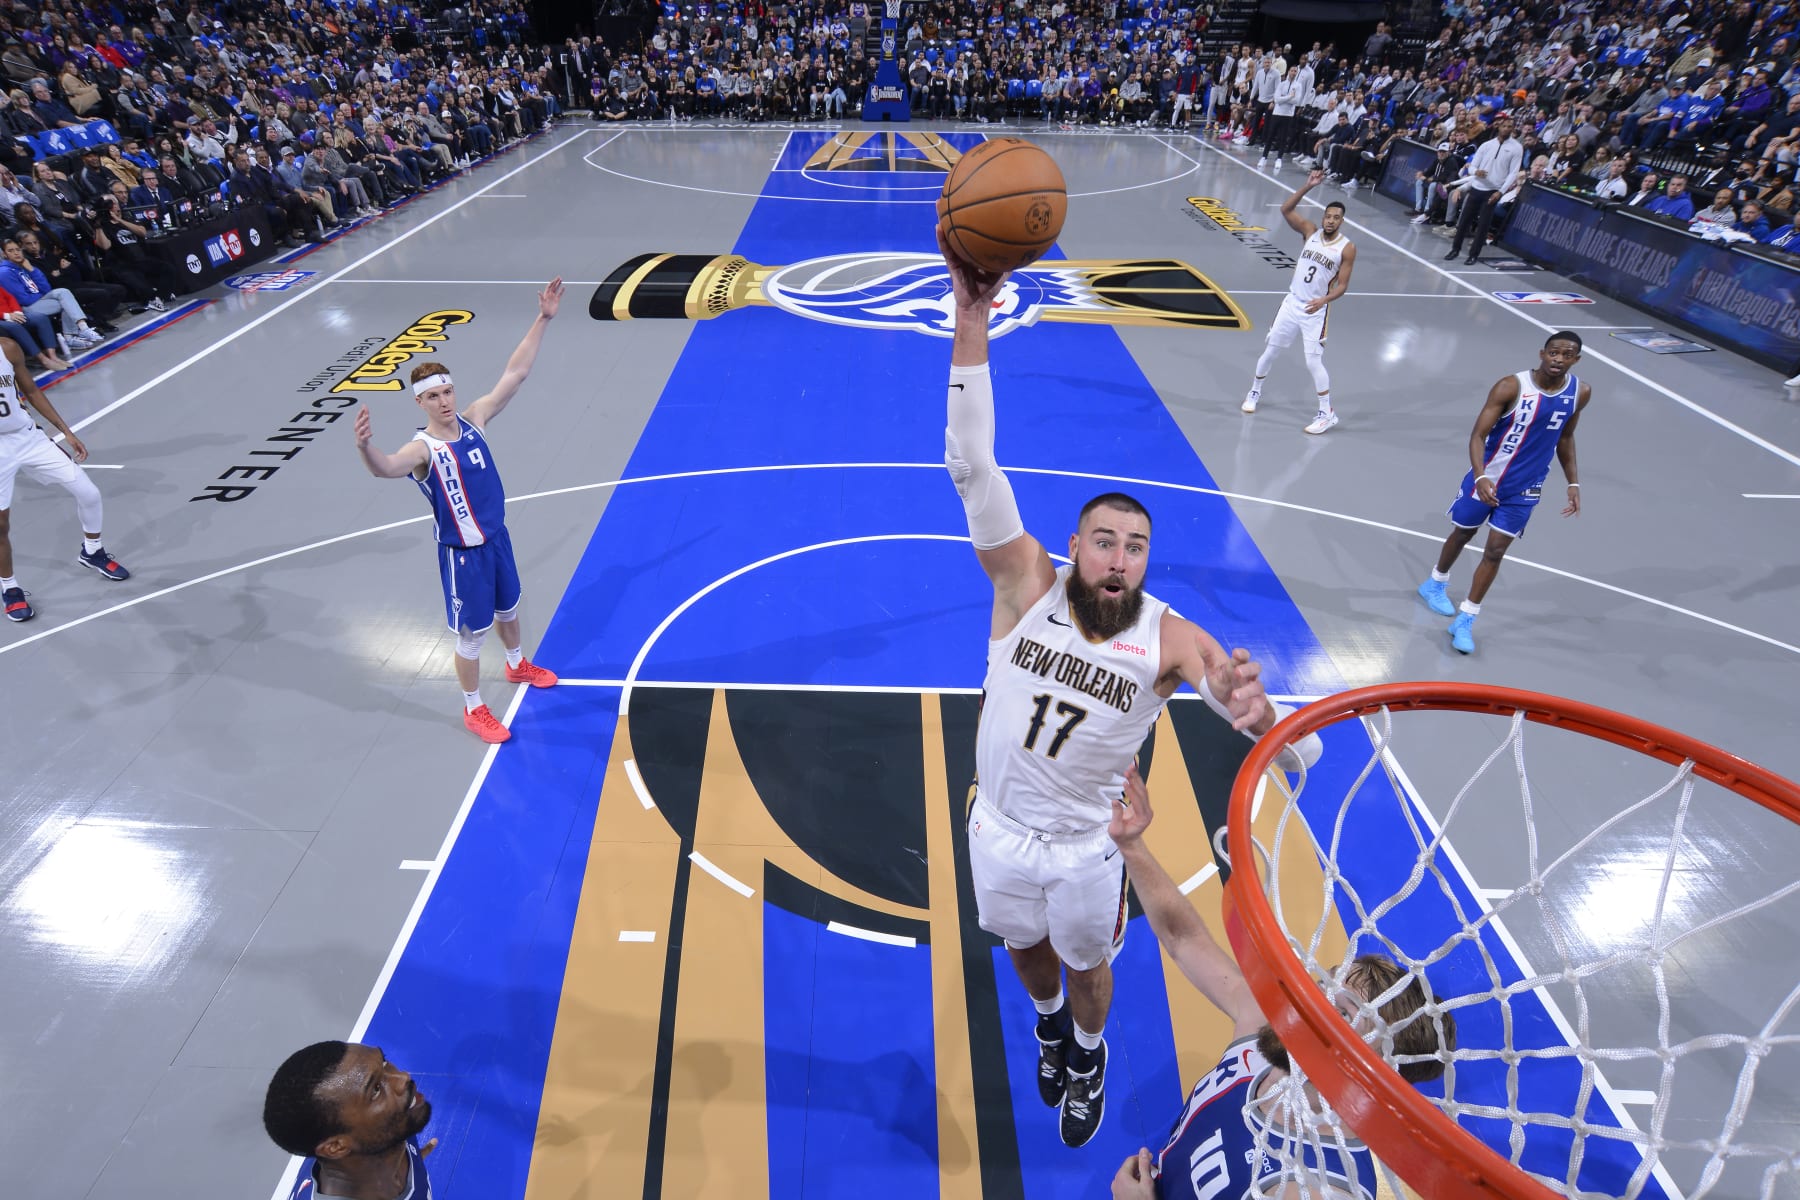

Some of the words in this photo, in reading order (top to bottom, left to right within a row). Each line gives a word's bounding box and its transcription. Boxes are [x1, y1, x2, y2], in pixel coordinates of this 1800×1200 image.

[207, 243, 224, 262] NBA
[1512, 203, 1543, 235] MORE
[1575, 226, 1618, 265] MORE
[1303, 265, 1317, 284] 3
[1695, 269, 1734, 306] NBA
[1721, 279, 1779, 325] League
[337, 336, 386, 363] Credit
[350, 309, 475, 378] Golden
[296, 365, 355, 393] Union
[1502, 399, 1532, 455] KINGS
[1546, 411, 1567, 430] 5
[188, 396, 359, 503] CENTER
[467, 448, 486, 470] 9
[438, 451, 469, 520] KINGS
[1010, 636, 1058, 678] NEW
[1054, 652, 1138, 714] ORLEANS
[1112, 640, 1147, 657] ibotta
[1022, 693, 1088, 761] 17
[1189, 1127, 1231, 1200] 10
